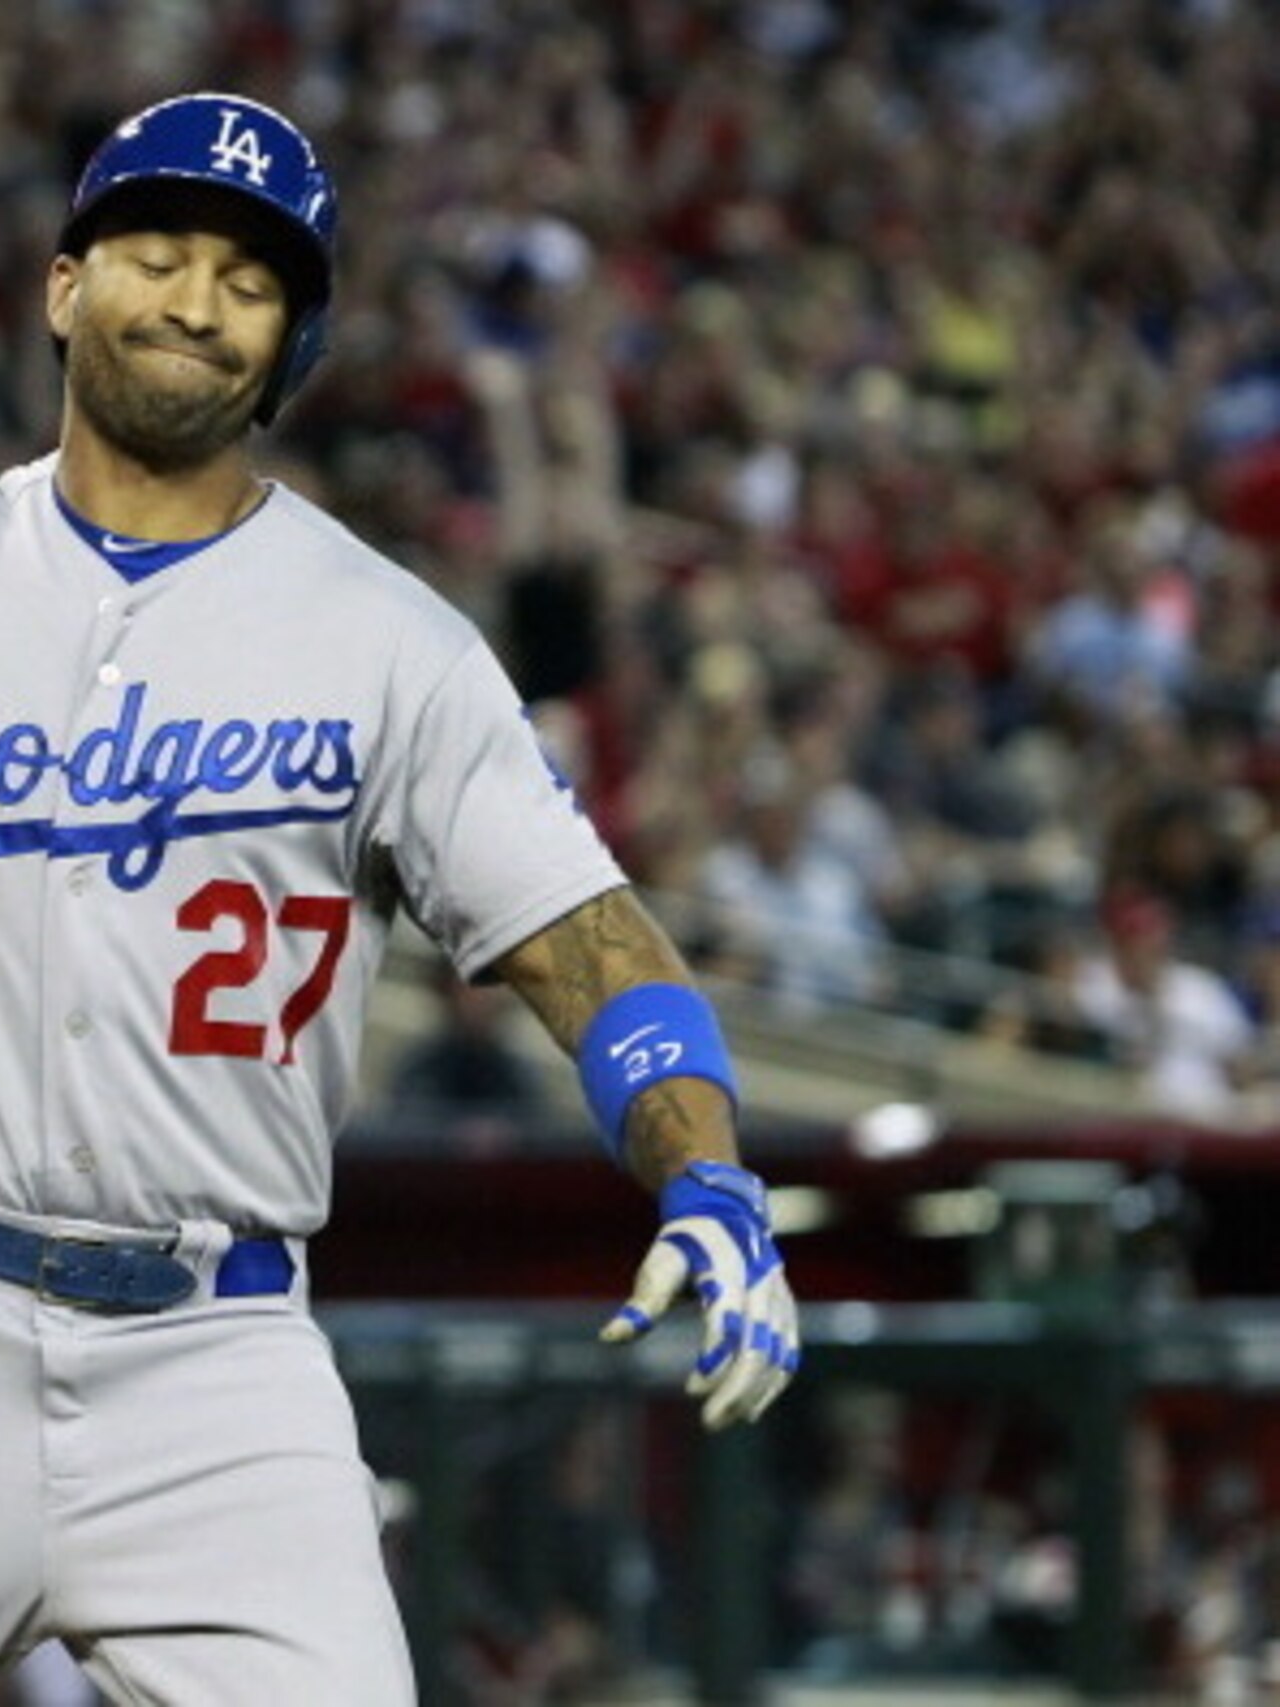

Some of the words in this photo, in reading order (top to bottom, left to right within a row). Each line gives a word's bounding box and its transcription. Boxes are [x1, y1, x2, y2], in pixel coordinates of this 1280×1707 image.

[210, 109, 272, 186] LA
[168, 879, 353, 1065] 27
[624, 1041, 683, 1083] 27
